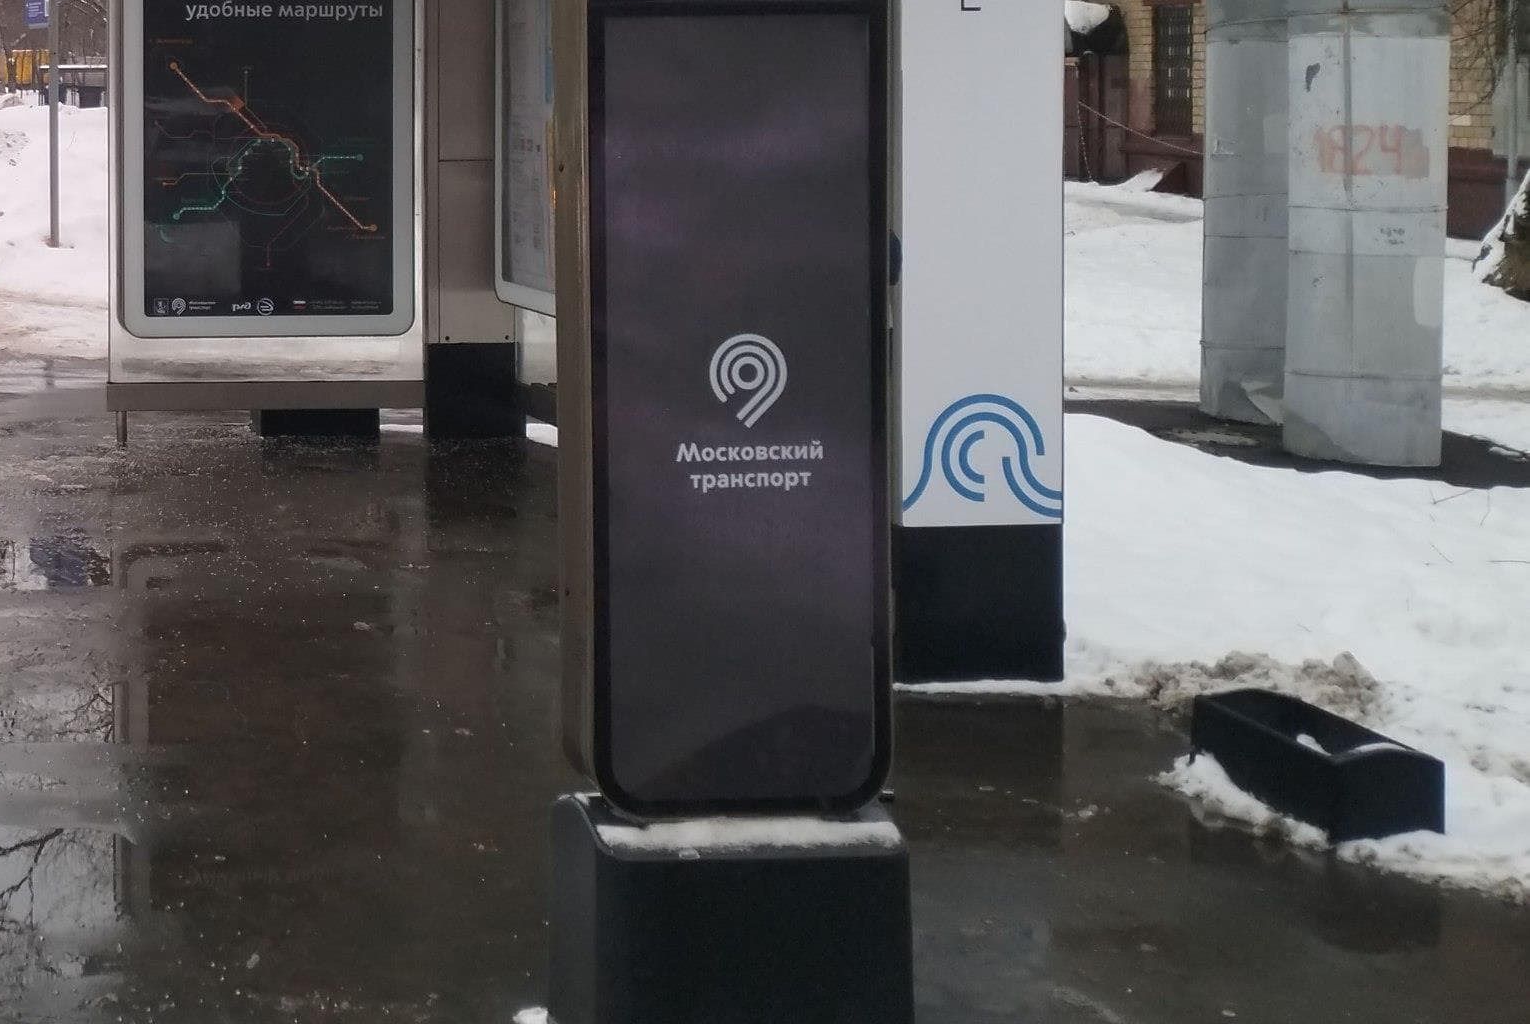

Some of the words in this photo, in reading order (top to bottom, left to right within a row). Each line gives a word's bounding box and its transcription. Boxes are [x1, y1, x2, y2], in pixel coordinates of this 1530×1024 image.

[185, 0, 273, 21] удобные
[278, 4, 384, 21] маршруты
[676, 440, 824, 463] Московский
[689, 471, 812, 494] транспорт
